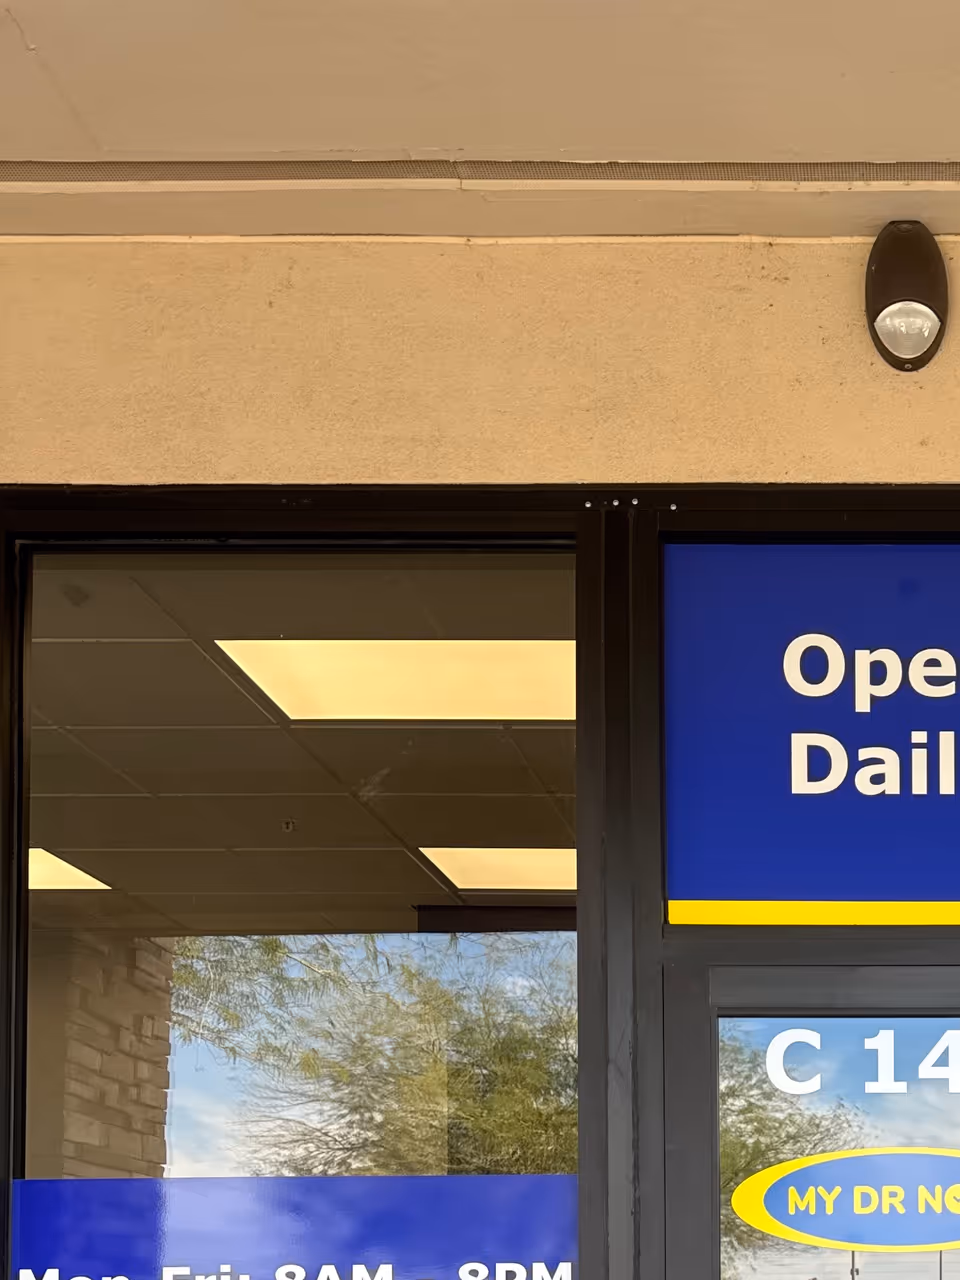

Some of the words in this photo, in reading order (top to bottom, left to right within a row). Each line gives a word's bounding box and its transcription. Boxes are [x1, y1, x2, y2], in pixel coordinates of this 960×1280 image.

[765, 1028, 822, 1096] C
[788, 1185, 842, 1216] MY
[853, 1185, 907, 1216] DR
